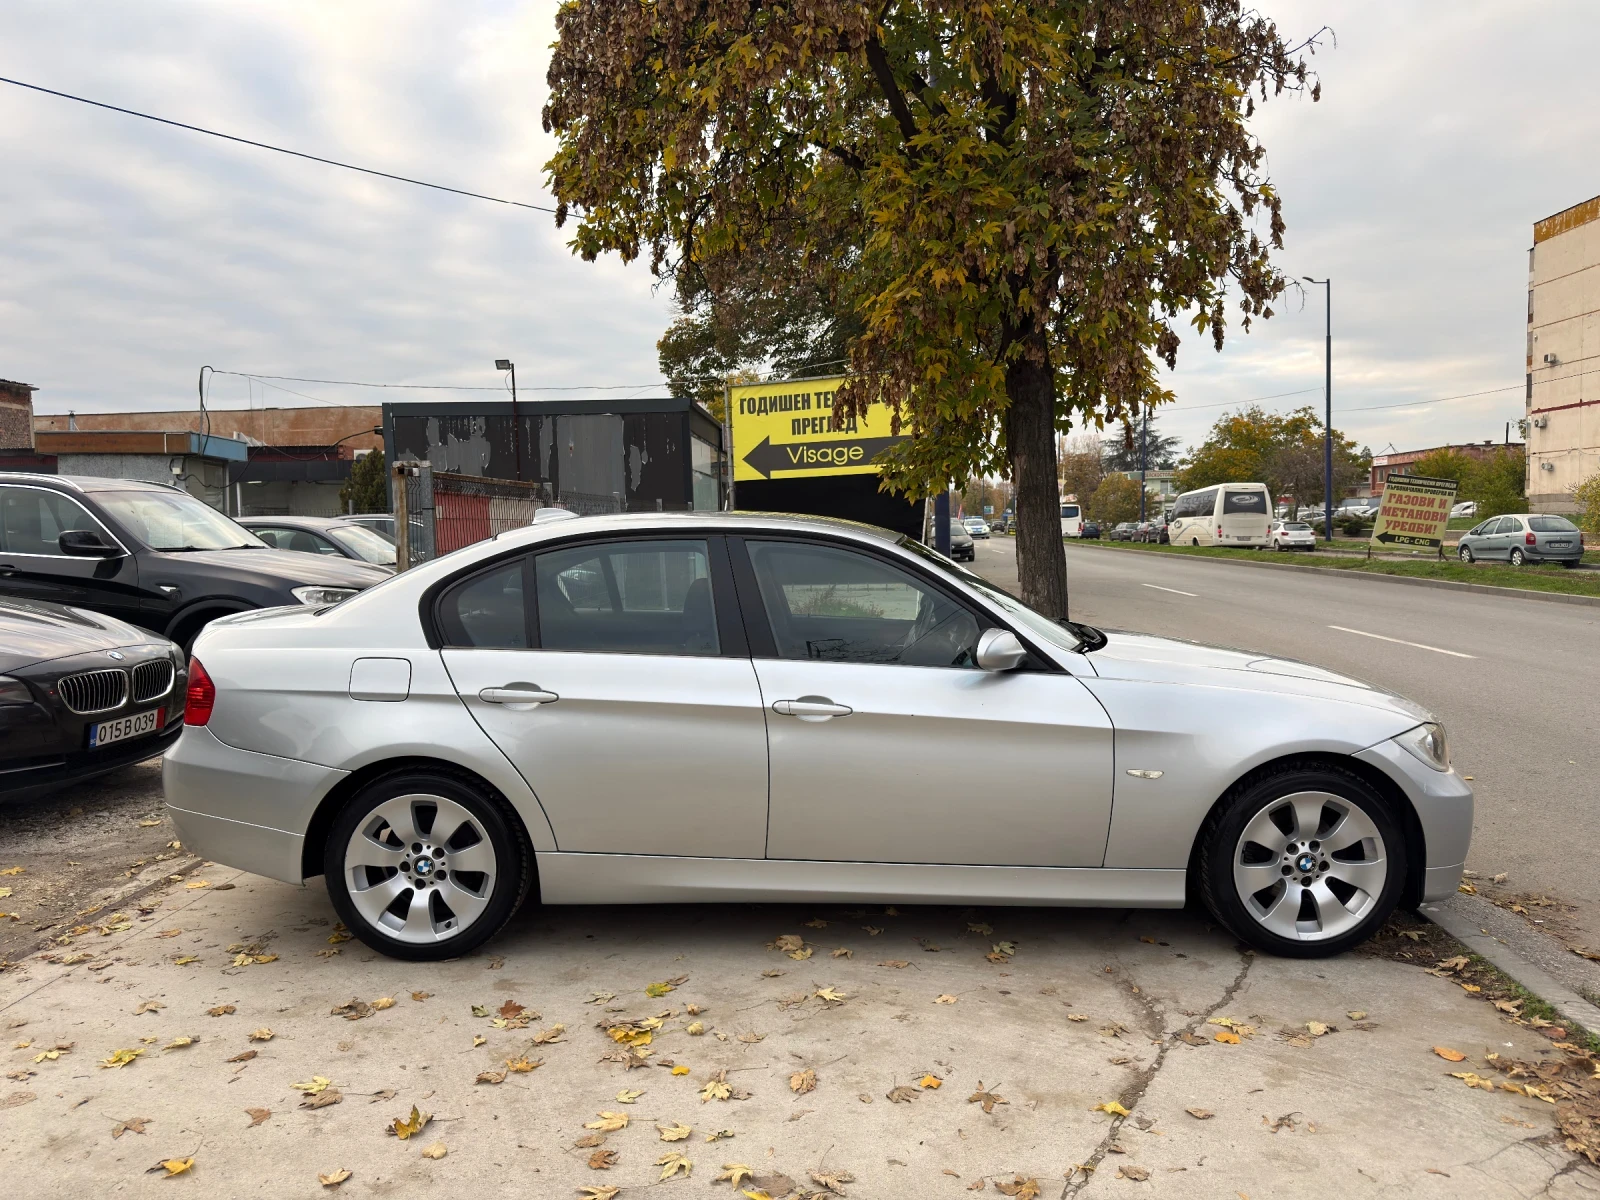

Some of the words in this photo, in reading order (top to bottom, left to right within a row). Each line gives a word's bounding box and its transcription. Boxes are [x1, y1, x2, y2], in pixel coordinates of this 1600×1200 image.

[739, 393, 811, 416] ГОДИШЕН
[786, 445, 864, 465] Visage
[1388, 493, 1436, 507] ГАЗОВИ
[1438, 498, 1448, 509] И
[1380, 506, 1448, 522] МЕТАНОВИ
[1384, 520, 1438, 535] УРЕДБИ!
[1414, 538, 1430, 546] CNG
